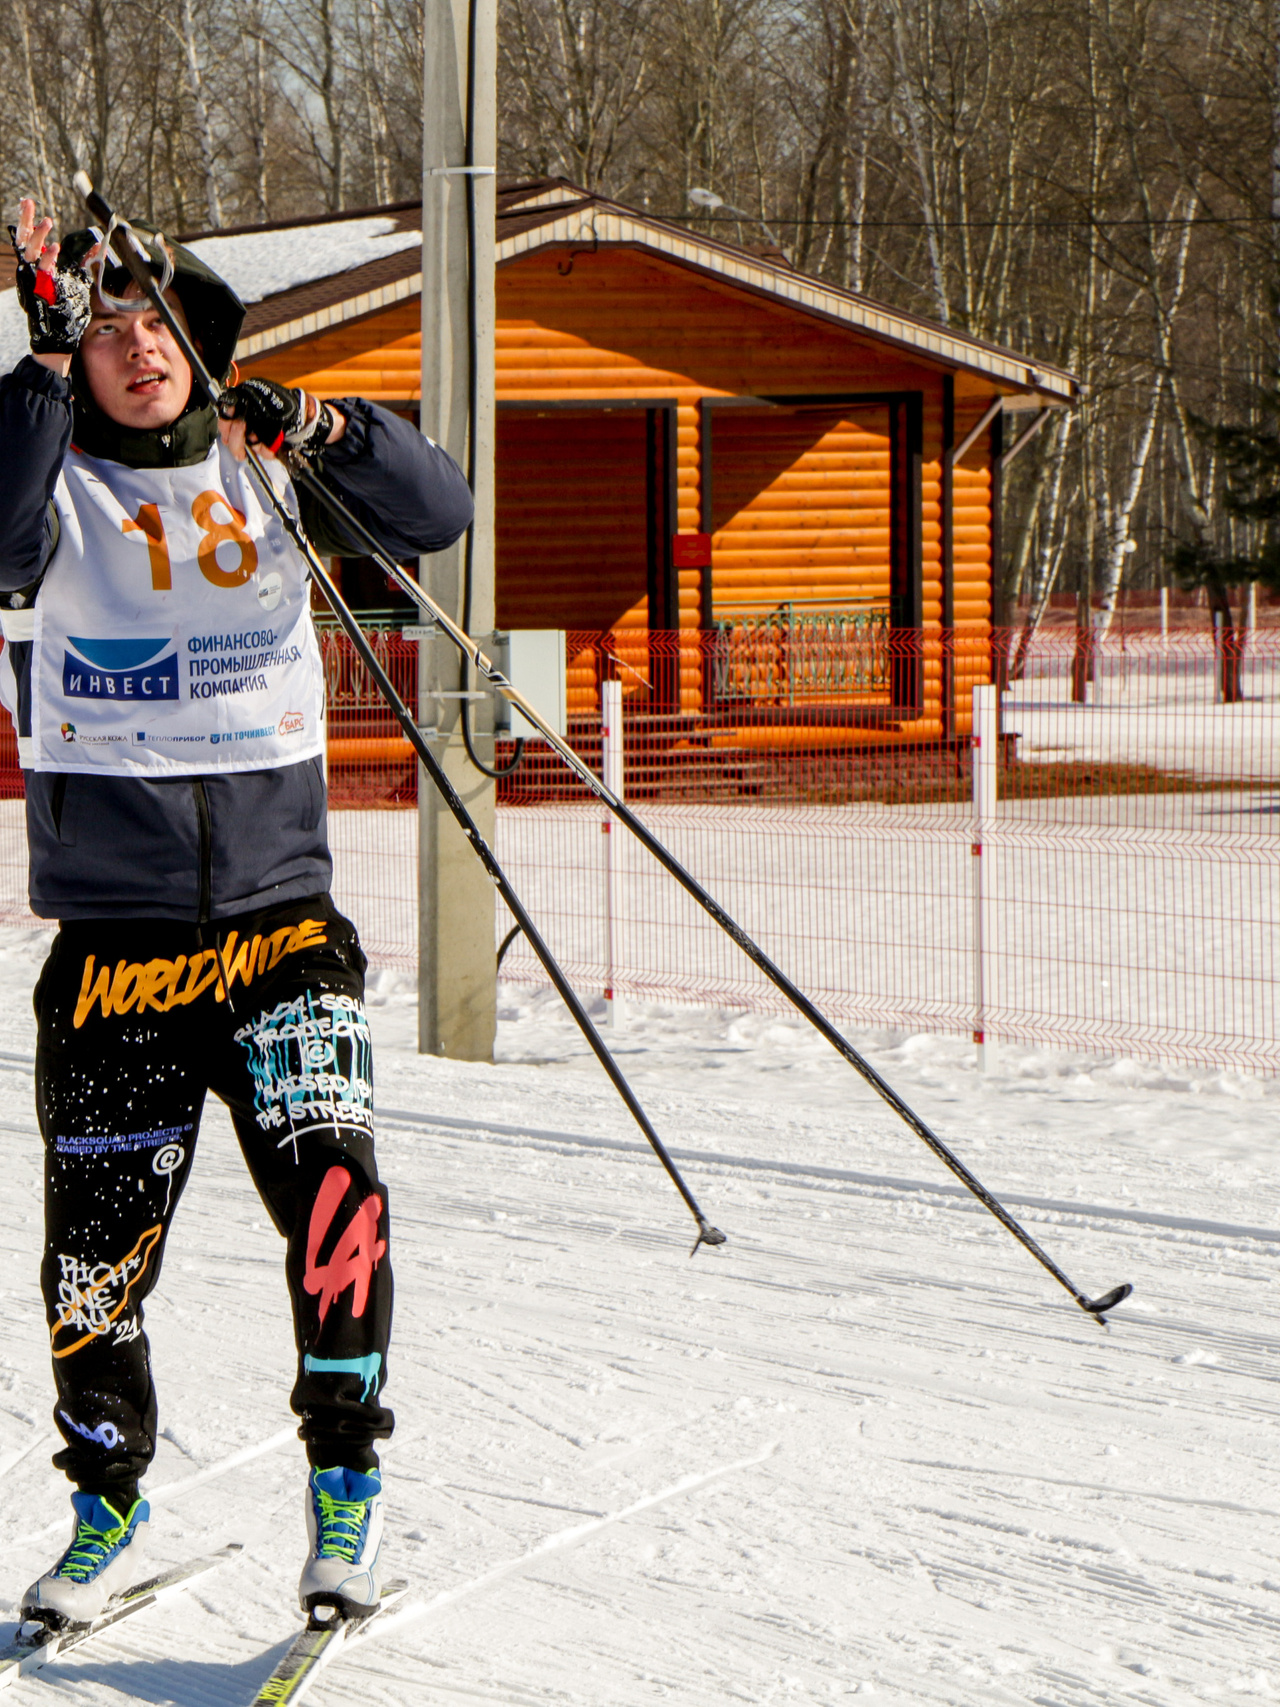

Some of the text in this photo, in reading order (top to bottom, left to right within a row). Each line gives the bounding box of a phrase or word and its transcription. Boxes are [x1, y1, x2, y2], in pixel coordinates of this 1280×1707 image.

[121, 489, 259, 591] 18
[187, 628, 278, 655] ФИНАНСОВО-
[189, 645, 302, 677] ПРОМЫШЛЕННАЯ
[69, 673, 171, 695] ИНВЕСТ
[190, 674, 268, 700] КОМПАНИЯ
[234, 725, 276, 741] ТОЧИНВЕСТ
[284, 717, 304, 732] БАРС
[147, 735, 206, 743] ТЕПЛОПРИБОР
[256, 1105, 286, 1131] THE
[56, 1134, 126, 1146] BLACKSQUAD
[128, 1125, 183, 1143] PROJECTS
[56, 1144, 93, 1155] RAISED
[94, 1144, 109, 1154] BY
[110, 1145, 133, 1153] THE
[58, 1279, 117, 1310] ONE
